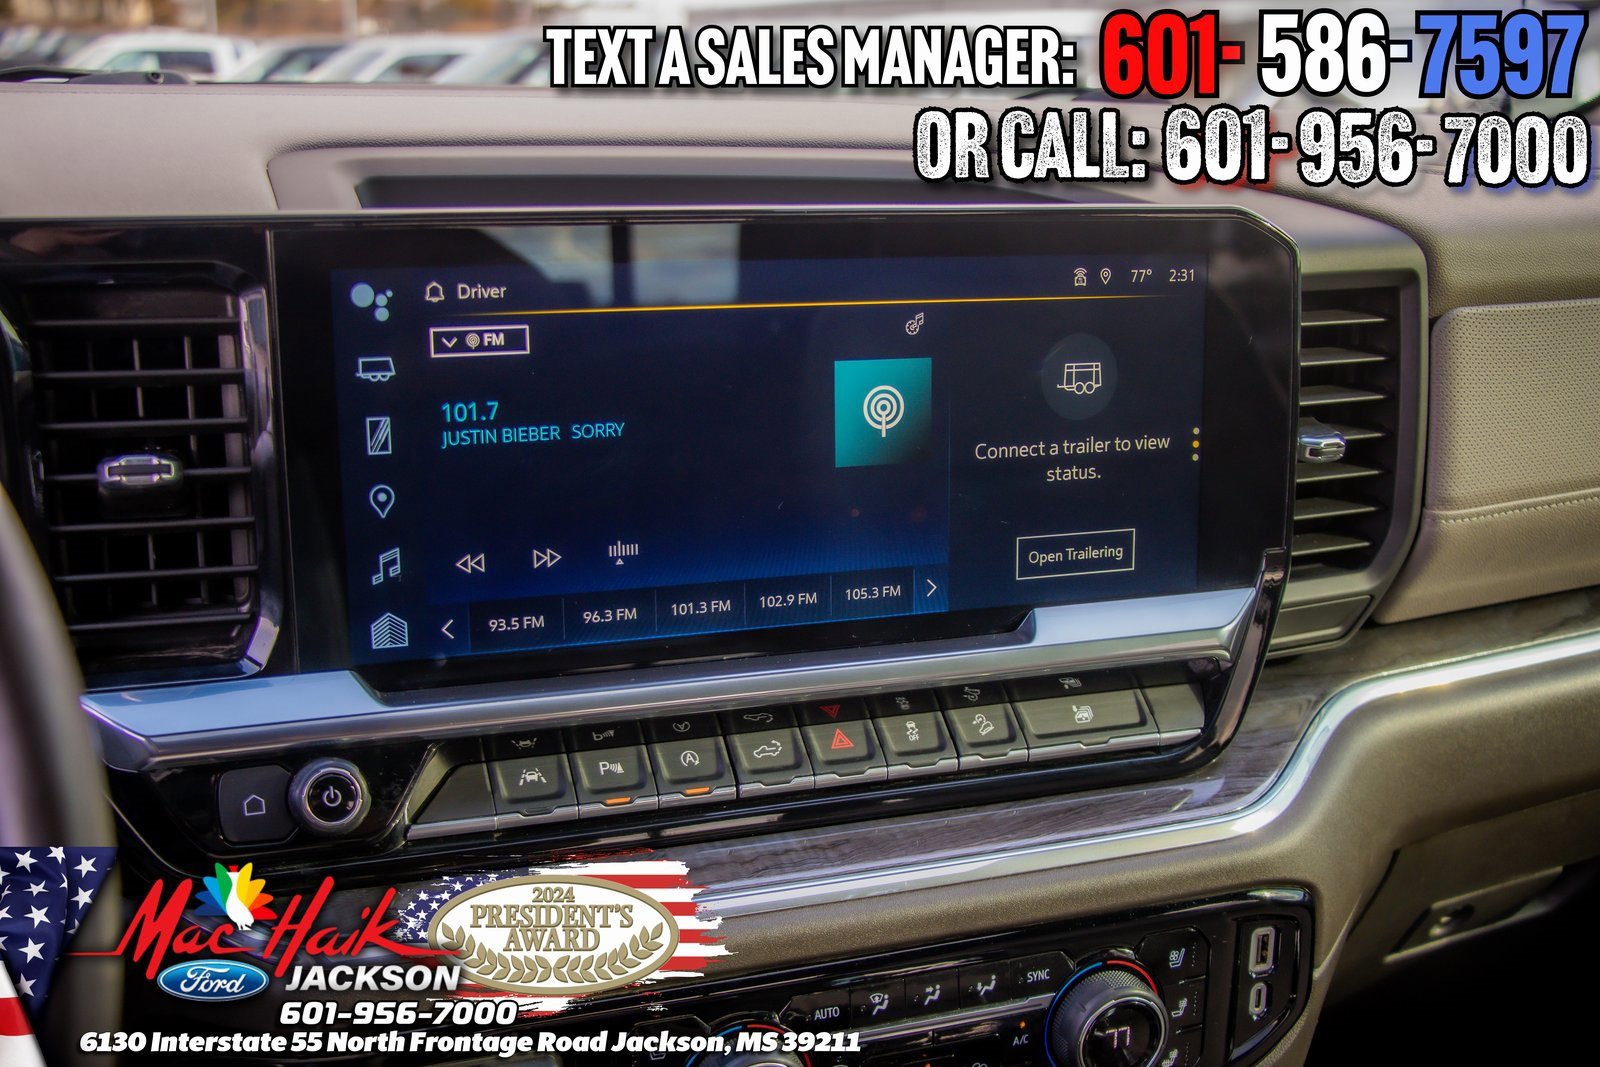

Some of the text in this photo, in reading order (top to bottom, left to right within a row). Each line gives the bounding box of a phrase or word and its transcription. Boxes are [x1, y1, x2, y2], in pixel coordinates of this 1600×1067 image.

[1169, 268, 1195, 282] 2:31
[457, 283, 507, 299] Driver
[483, 332, 505, 347] FM
[441, 400, 500, 423] 101.7
[441, 421, 625, 449] JUSTIN BIEBER SORRY
[975, 434, 1170, 460] Connect a trailer to view
[1046, 464, 1102, 482] status.
[1028, 545, 1123, 567] Open Trailering
[759, 592, 818, 609] 102.9 FM
[845, 584, 902, 601] 105.3 FM
[583, 607, 637, 624] 96.3 FM
[671, 599, 732, 616] 101.3 FM
[489, 615, 545, 632] 93.5 FM
[1027, 969, 1050, 983] SYNC
[814, 1006, 840, 1021] AUTO
[1012, 1034, 1029, 1047] A/C
[1106, 1027, 1131, 1049] 77
